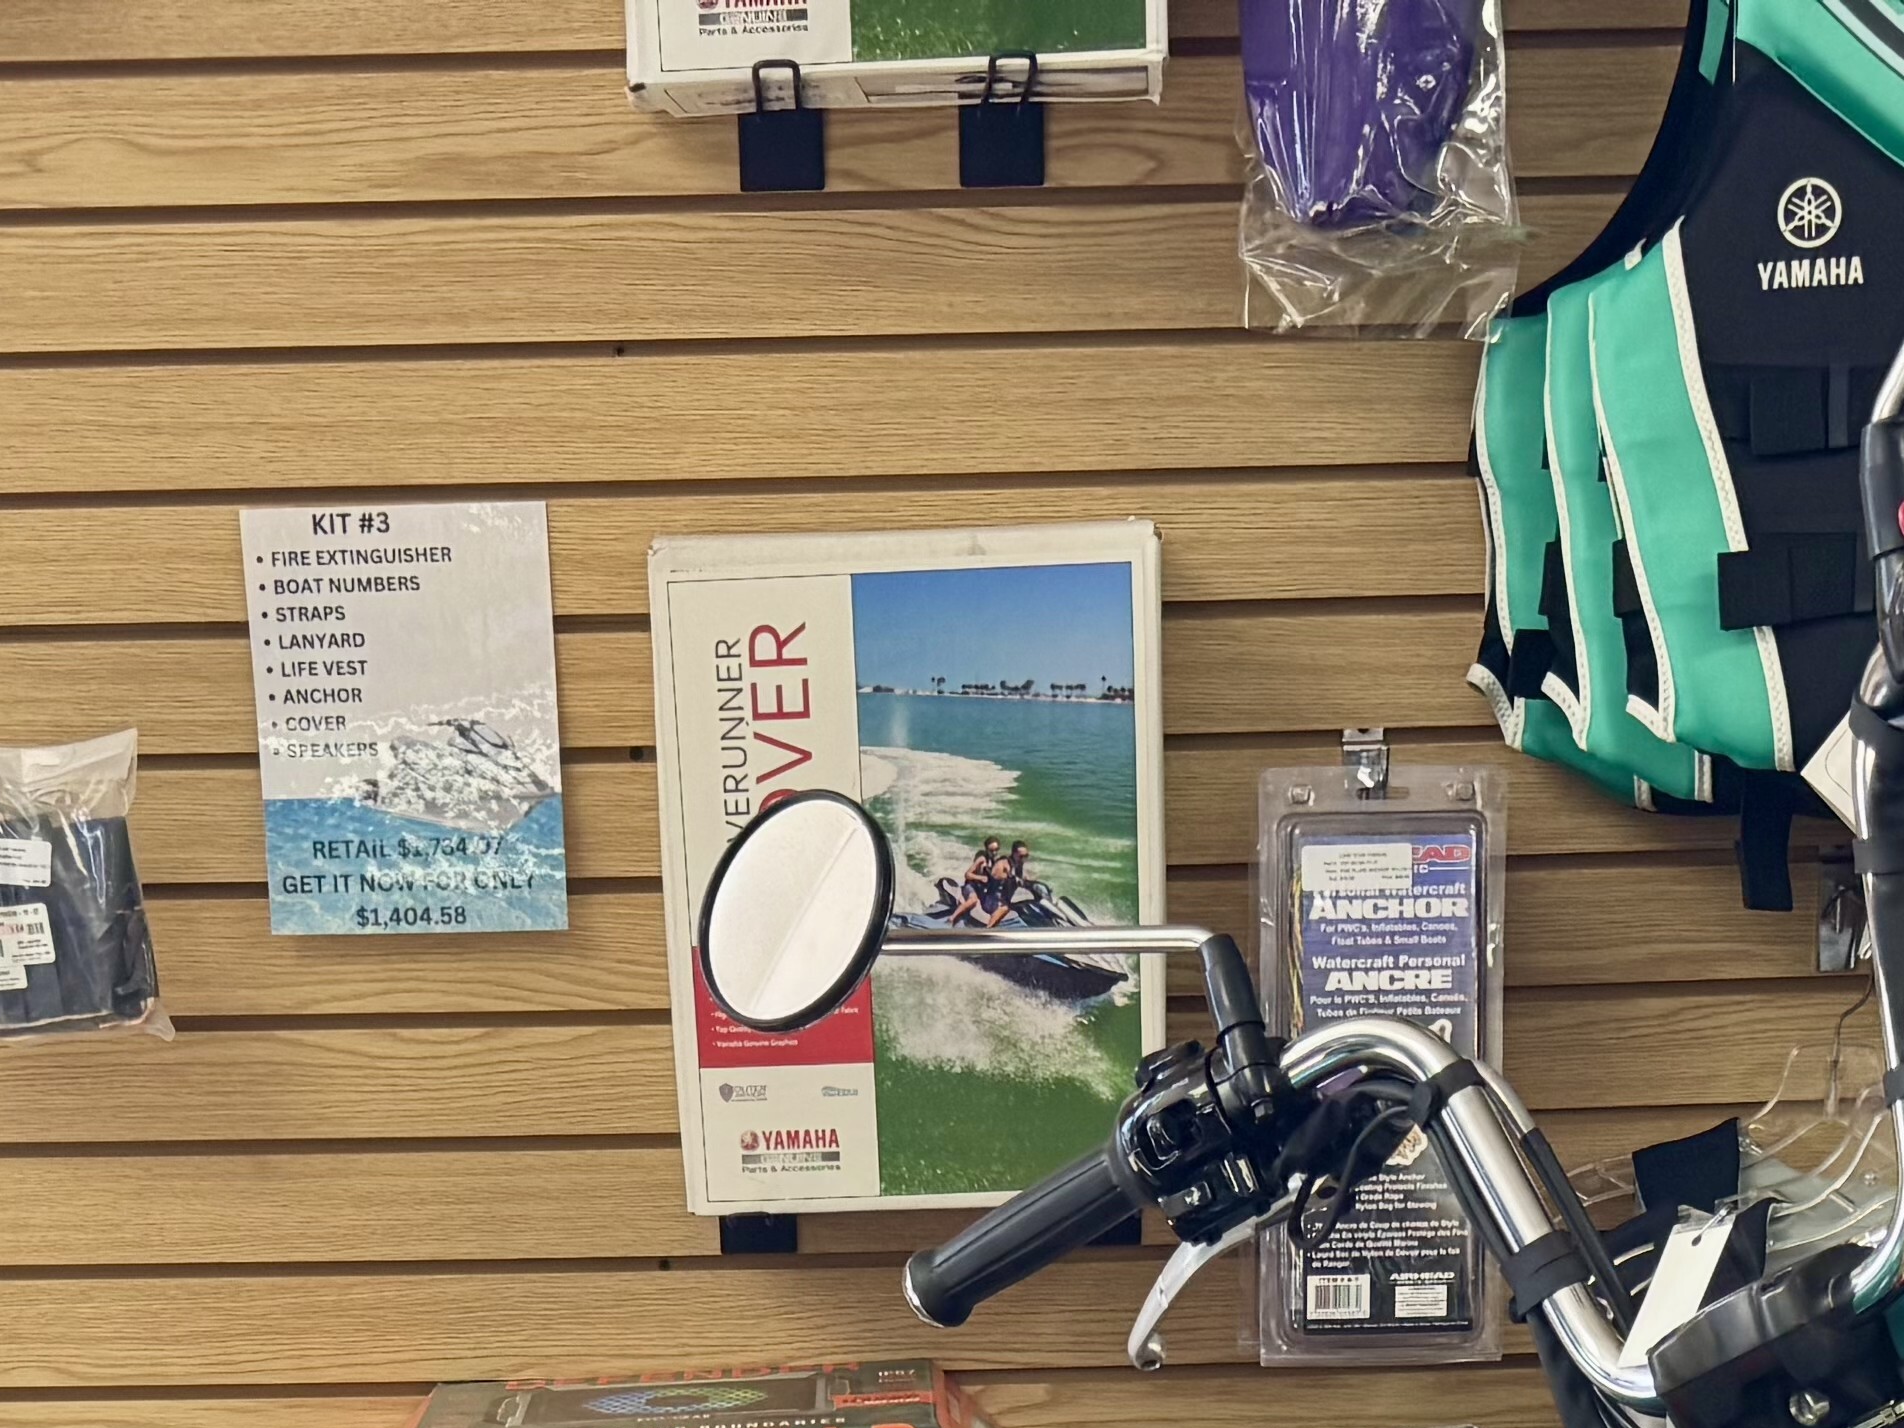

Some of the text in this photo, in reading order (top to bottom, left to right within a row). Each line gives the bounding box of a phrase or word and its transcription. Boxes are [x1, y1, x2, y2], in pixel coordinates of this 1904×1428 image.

[1758, 256, 1864, 290] YAMAHA
[312, 512, 390, 534] KIT #3
[271, 547, 452, 567] FIRE EXTINGUISHER
[274, 576, 420, 595] BOAT NUMBERS
[276, 606, 346, 622] STRAPS
[278, 632, 366, 650] LANYARD
[281, 660, 367, 677] LIFE VEST
[283, 688, 363, 704] ANCHOR
[286, 716, 346, 732] COVER
[748, 621, 813, 812] VER
[715, 638, 750, 843] VERUNNER
[287, 742, 379, 759] SPEAKERS
[313, 840, 391, 859] RETAIL
[283, 876, 326, 894] GET
[333, 875, 354, 893] IT
[360, 874, 415, 893] NOW
[423, 873, 466, 891] FOR
[357, 906, 466, 928] $1,404.58
[1309, 897, 1469, 920] ANCHOR
[1312, 954, 1465, 969] Watercraft Personal
[1325, 969, 1452, 991] ANCRE
[762, 1128, 840, 1150] YAMAHA
[742, 1165, 768, 1173] Parts
